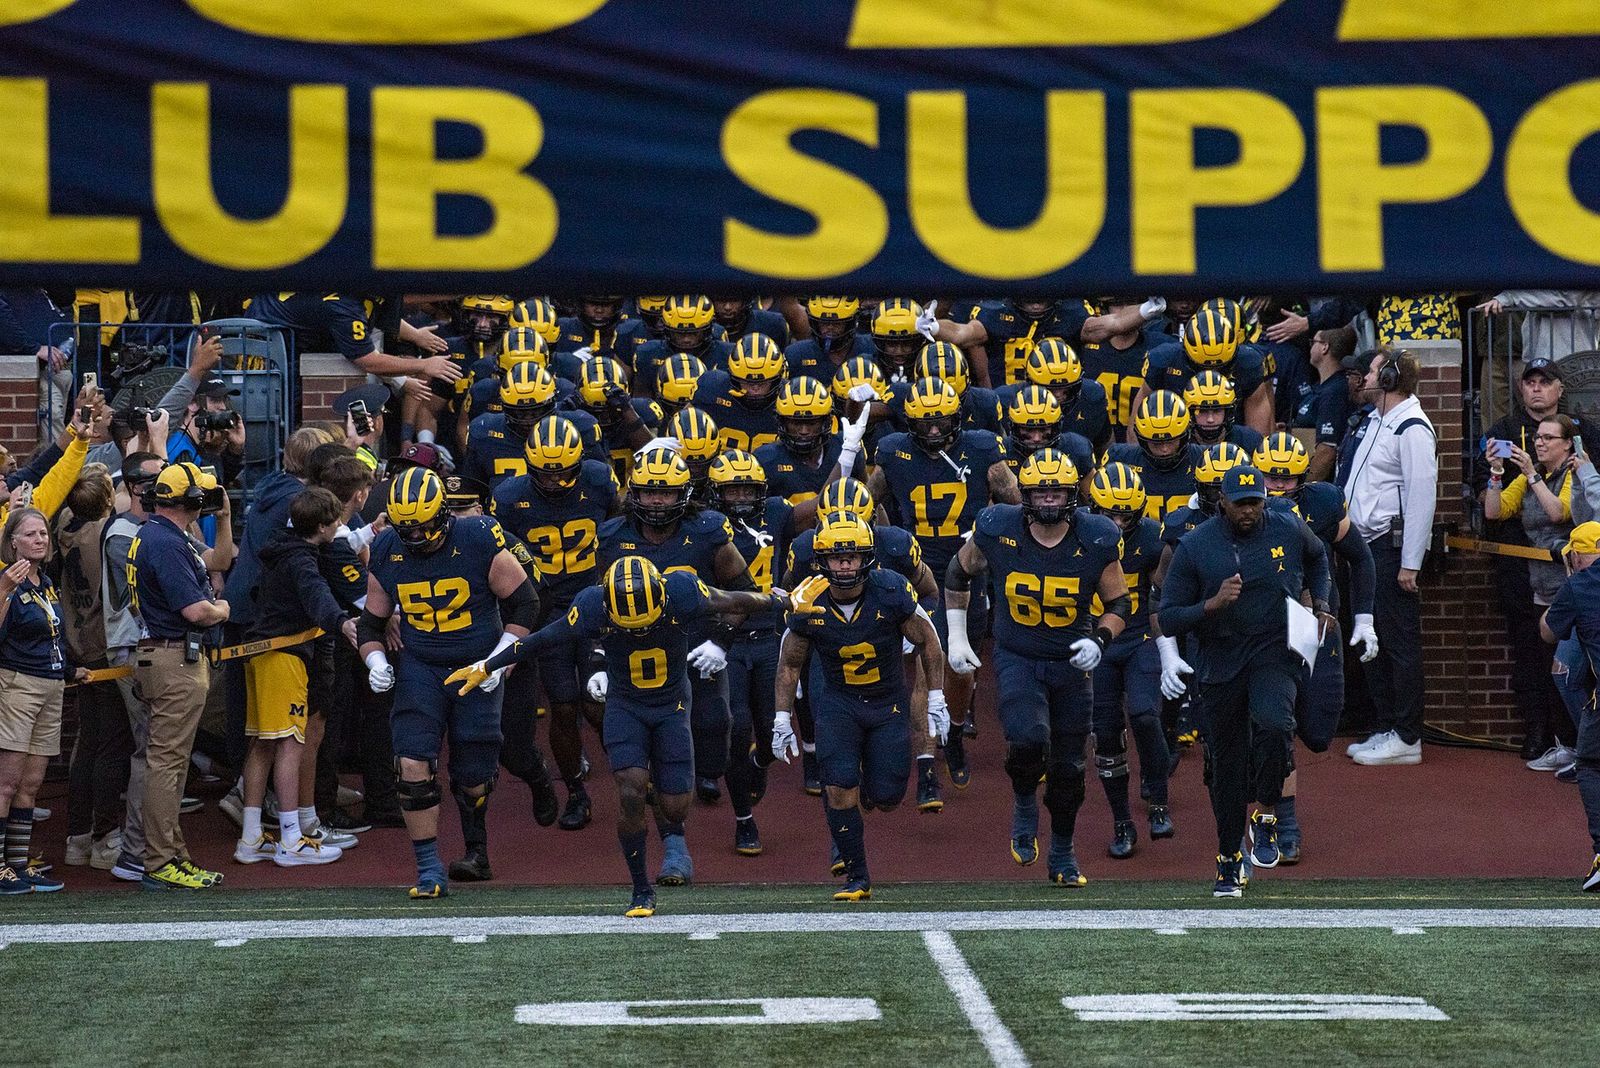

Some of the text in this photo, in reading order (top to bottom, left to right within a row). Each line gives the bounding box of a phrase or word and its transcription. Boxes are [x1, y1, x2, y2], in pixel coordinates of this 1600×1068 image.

[0, 78, 560, 271] LUB
[1239, 474, 1255, 486] M
[910, 482, 968, 537] 17
[527, 518, 597, 574] 32
[1271, 545, 1285, 559] M
[397, 577, 473, 632] 52
[1005, 571, 1081, 628] 65
[629, 647, 668, 689] 0
[838, 641, 881, 685] 2
[289, 703, 305, 718] M
